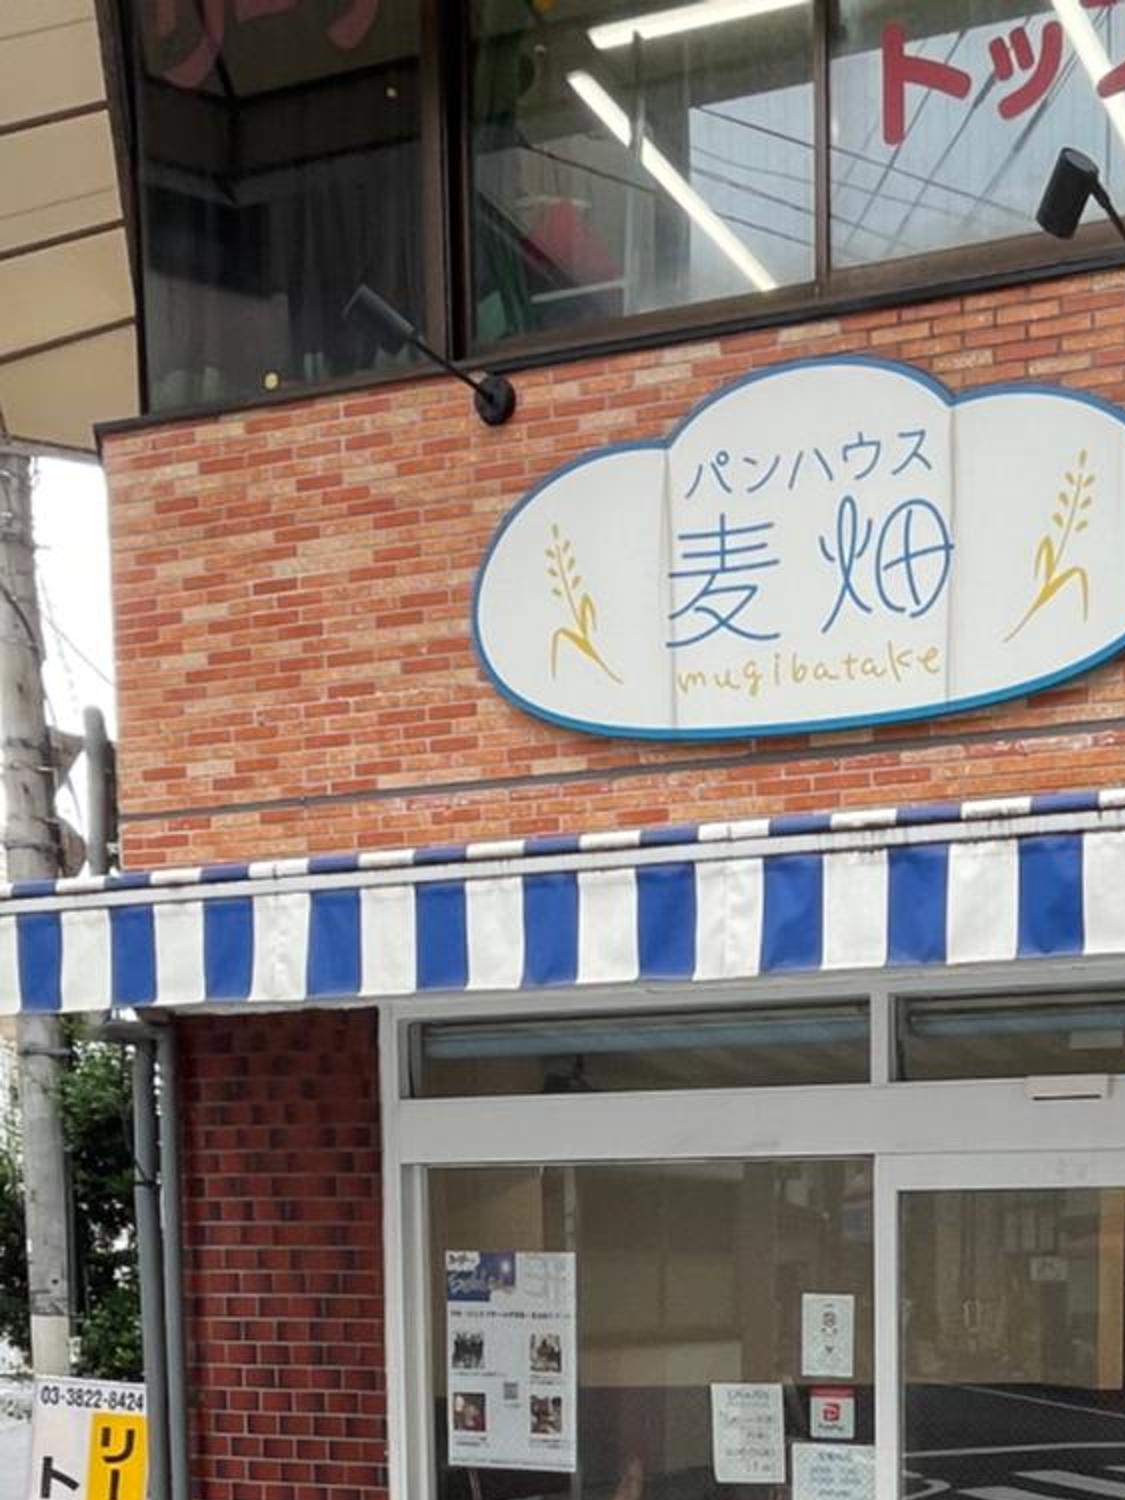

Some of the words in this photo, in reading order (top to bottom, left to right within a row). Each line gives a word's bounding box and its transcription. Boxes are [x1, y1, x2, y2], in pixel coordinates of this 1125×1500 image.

[684, 429, 933, 500] パンハウス
[665, 495, 955, 649] 麦畑
[676, 639, 943, 698] mugibatake
[40, 1385, 145, 1411] 03-3822-8424
